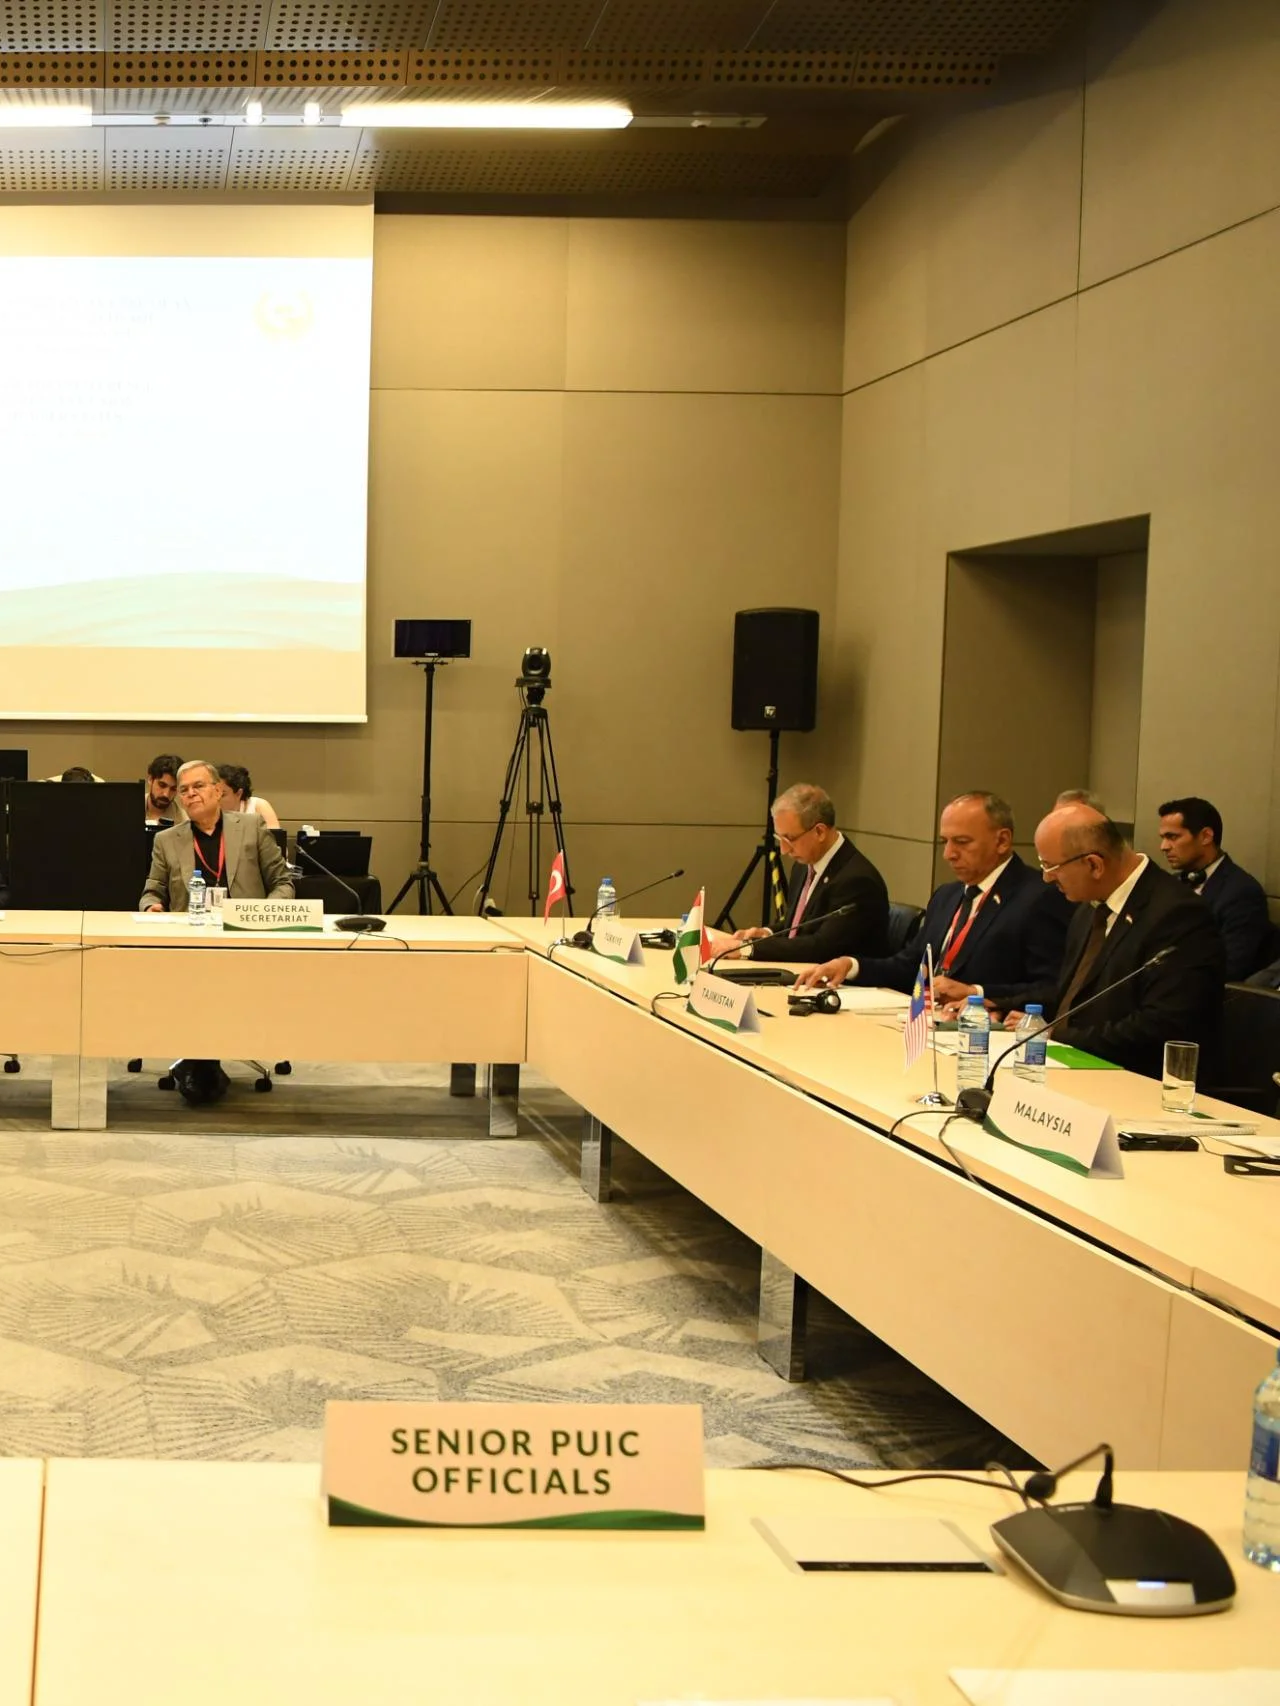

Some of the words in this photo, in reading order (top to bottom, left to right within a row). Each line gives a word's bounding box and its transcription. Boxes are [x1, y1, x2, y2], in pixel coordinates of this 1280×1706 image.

[235, 904, 260, 913] PUIC
[263, 904, 311, 913] GENERAL
[239, 914, 309, 923] SECRETARIAT
[1014, 1101, 1072, 1137] MALAYSIA
[390, 1428, 533, 1457] SENIOR
[551, 1429, 641, 1458] PUIC
[412, 1466, 612, 1495] OFFICIALS
